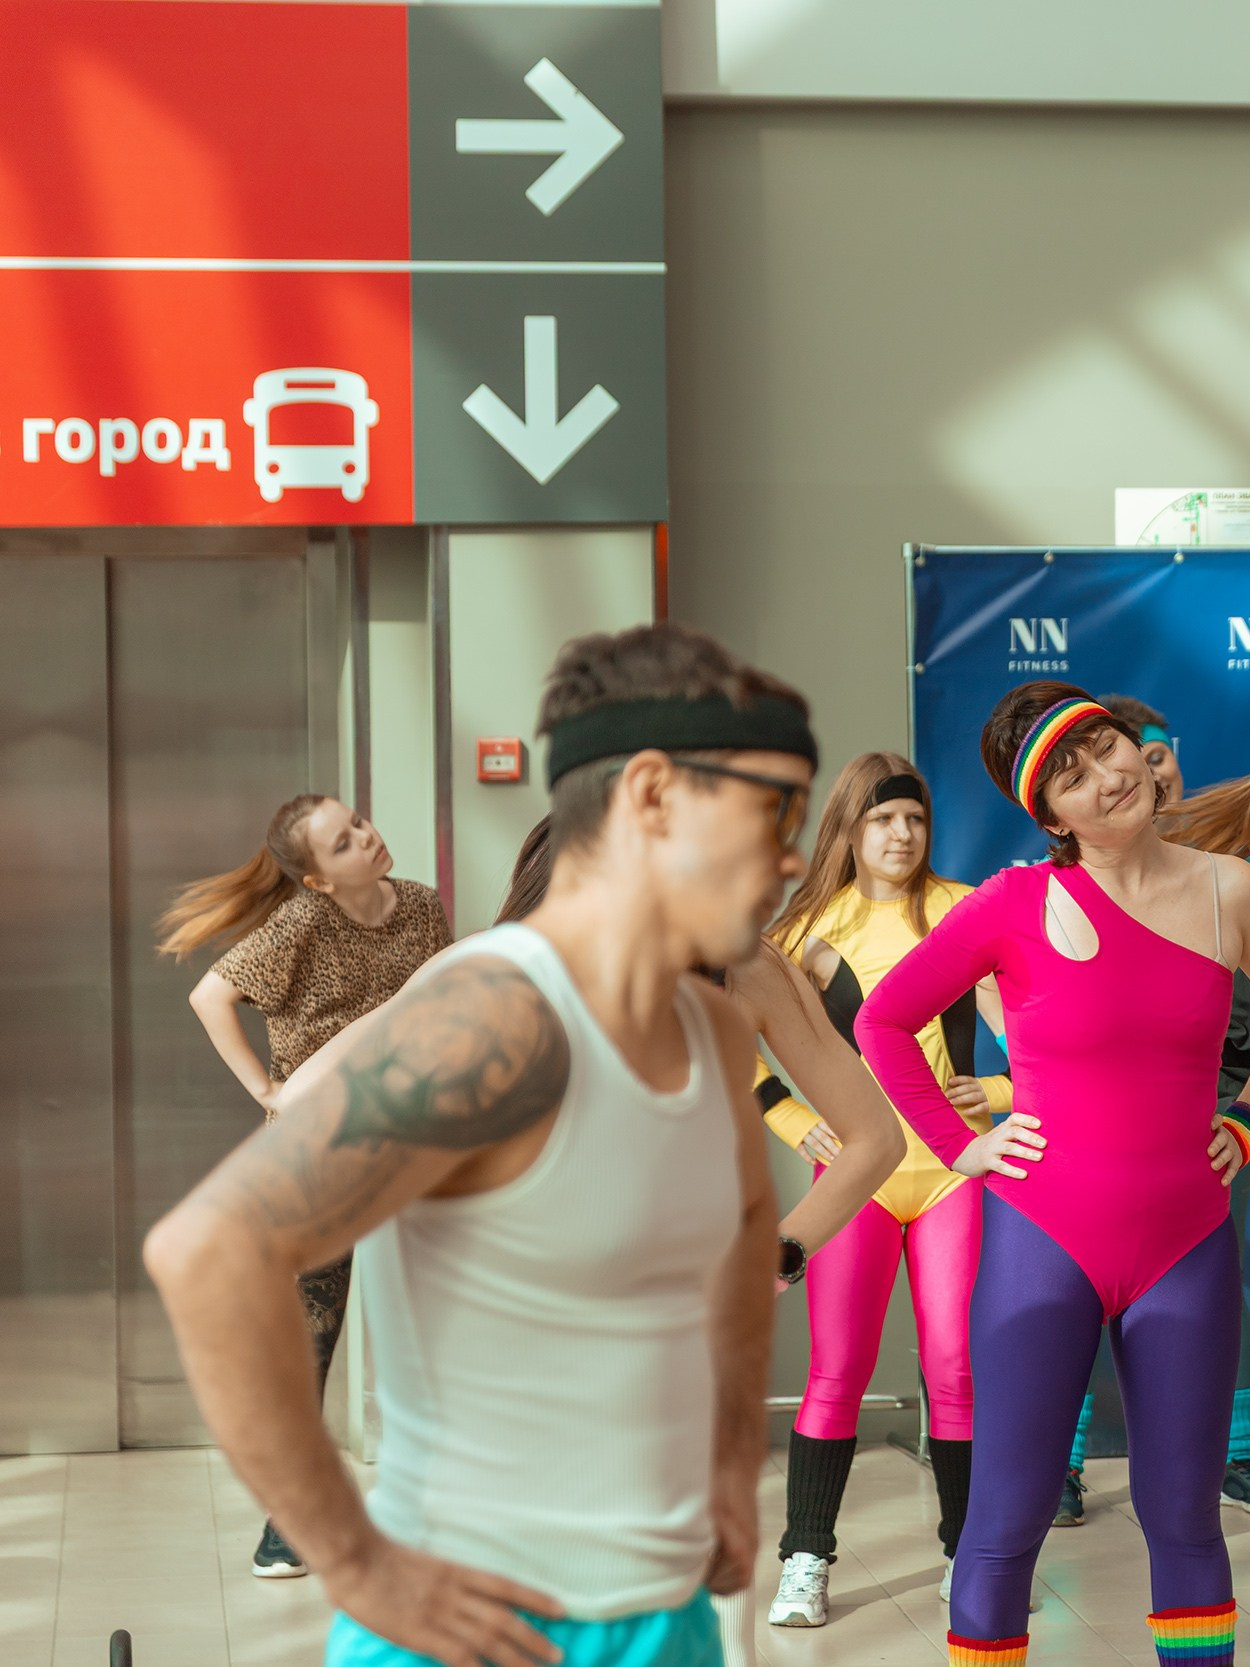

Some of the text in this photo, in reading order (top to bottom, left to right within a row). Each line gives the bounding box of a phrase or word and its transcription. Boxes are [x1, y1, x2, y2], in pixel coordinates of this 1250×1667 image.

[22, 417, 231, 477] город
[1008, 617, 1069, 654] NN
[1008, 660, 1069, 672] FITNESS
